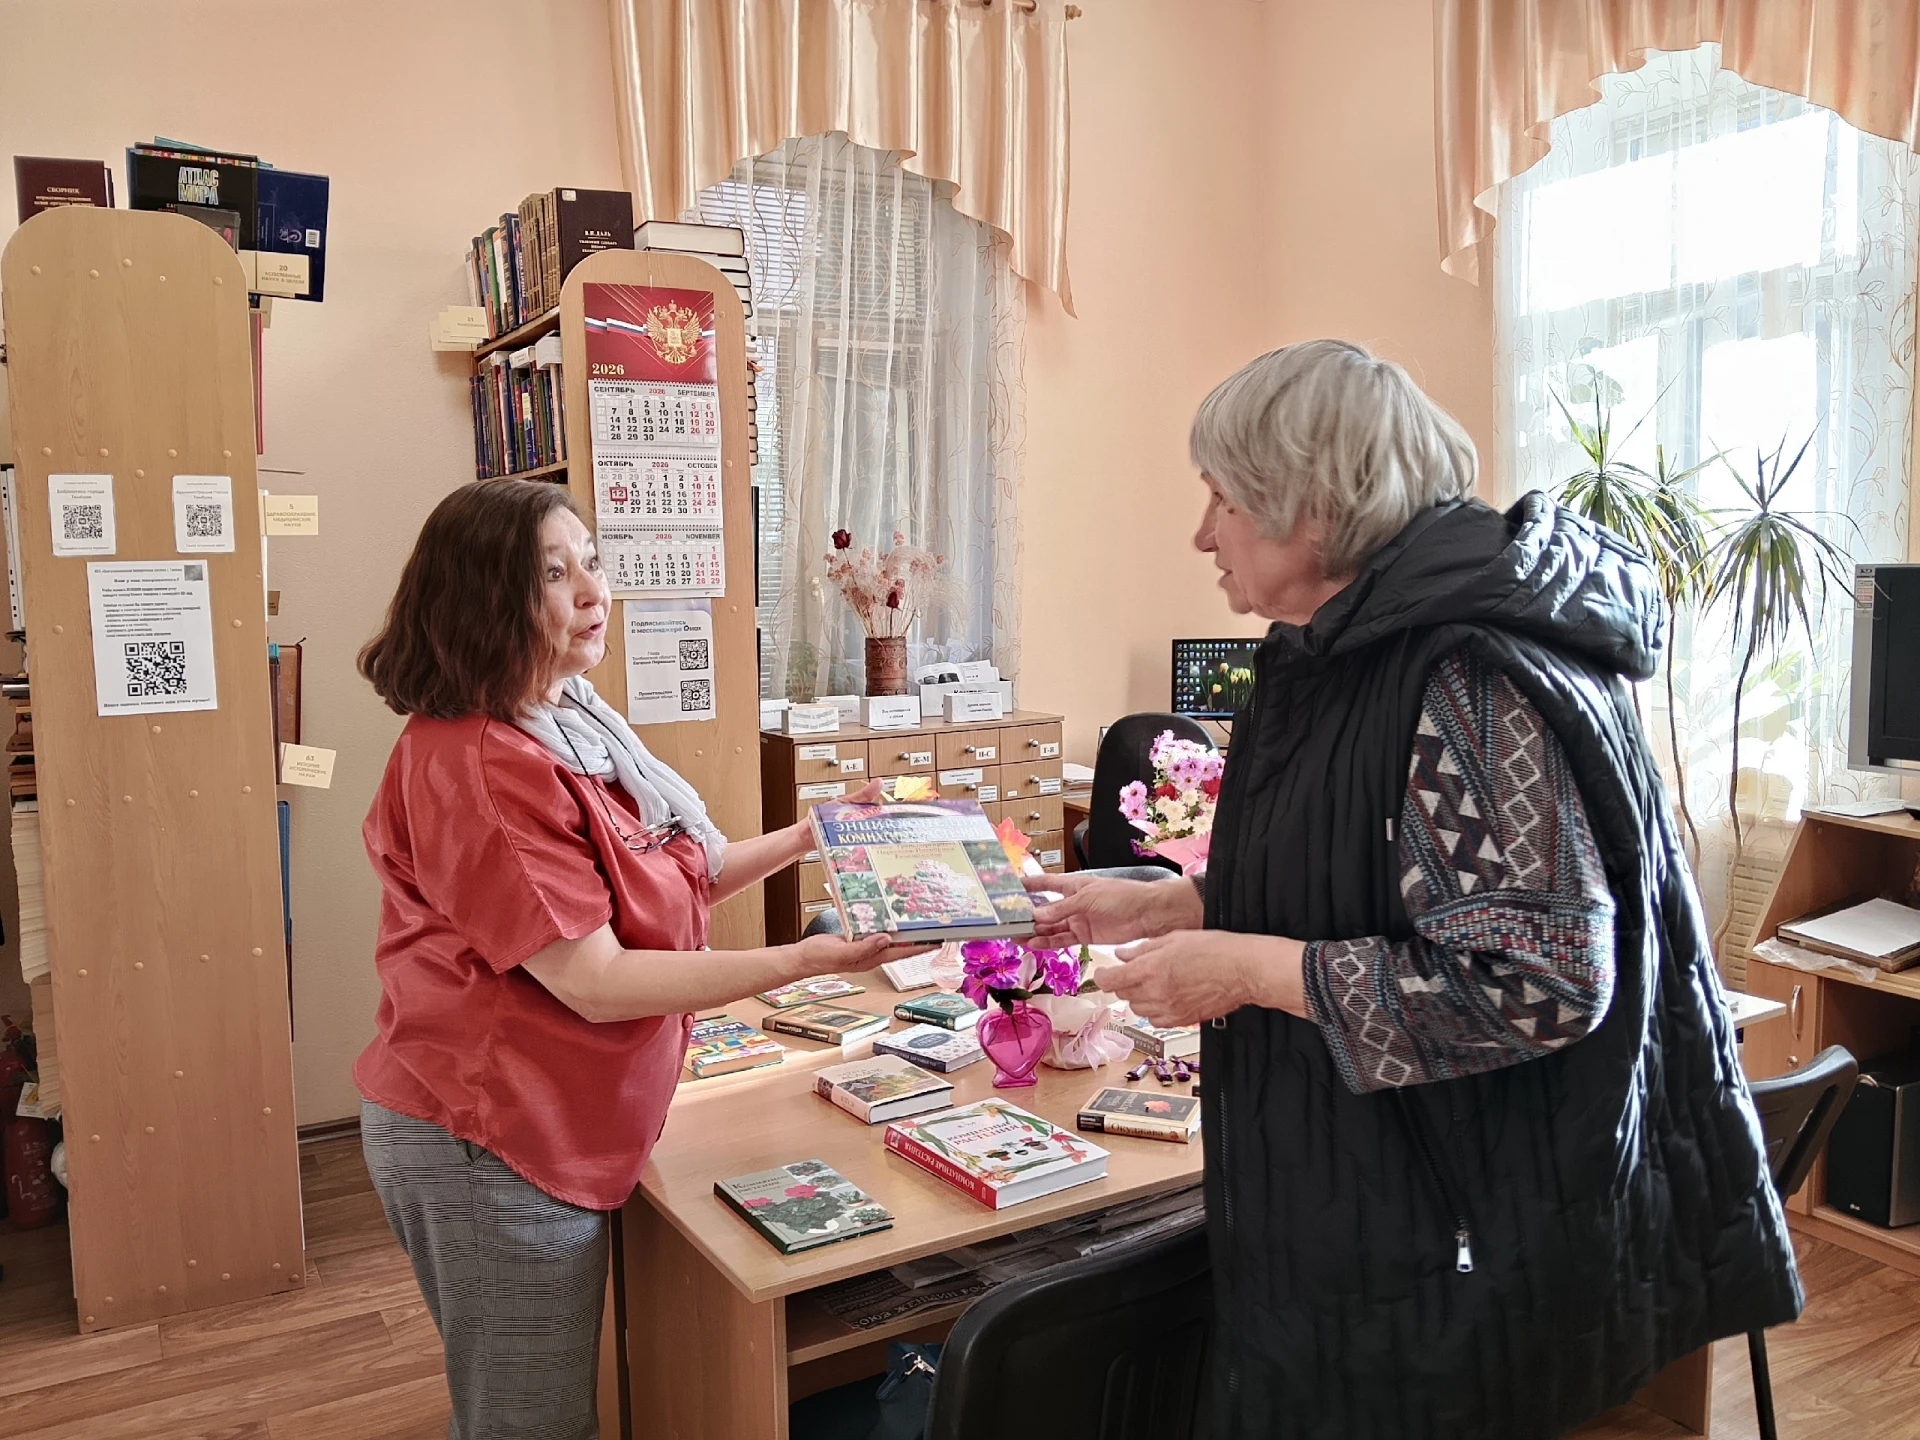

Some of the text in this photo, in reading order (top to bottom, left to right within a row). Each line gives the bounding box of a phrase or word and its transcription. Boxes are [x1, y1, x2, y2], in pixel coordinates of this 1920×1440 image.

[179, 166, 218, 186] АТЛАС
[178, 184, 219, 205] МИРА
[592, 363, 624, 375] 2026
[691, 1022, 744, 1037] ИГАМИ
[947, 1122, 1010, 1140] КОМНАТНЫЕ
[953, 1125, 1020, 1145] РАСТЕНИЯ
[1111, 1122, 1163, 1136] Окуджава
[904, 1142, 974, 1190] КОМНАТНЫЕ РАСТЕНИЯ
[732, 1176, 788, 1189] Комнатные
[738, 1181, 779, 1193] растения
[894, 1291, 958, 1314] ЖЕНЩИН
